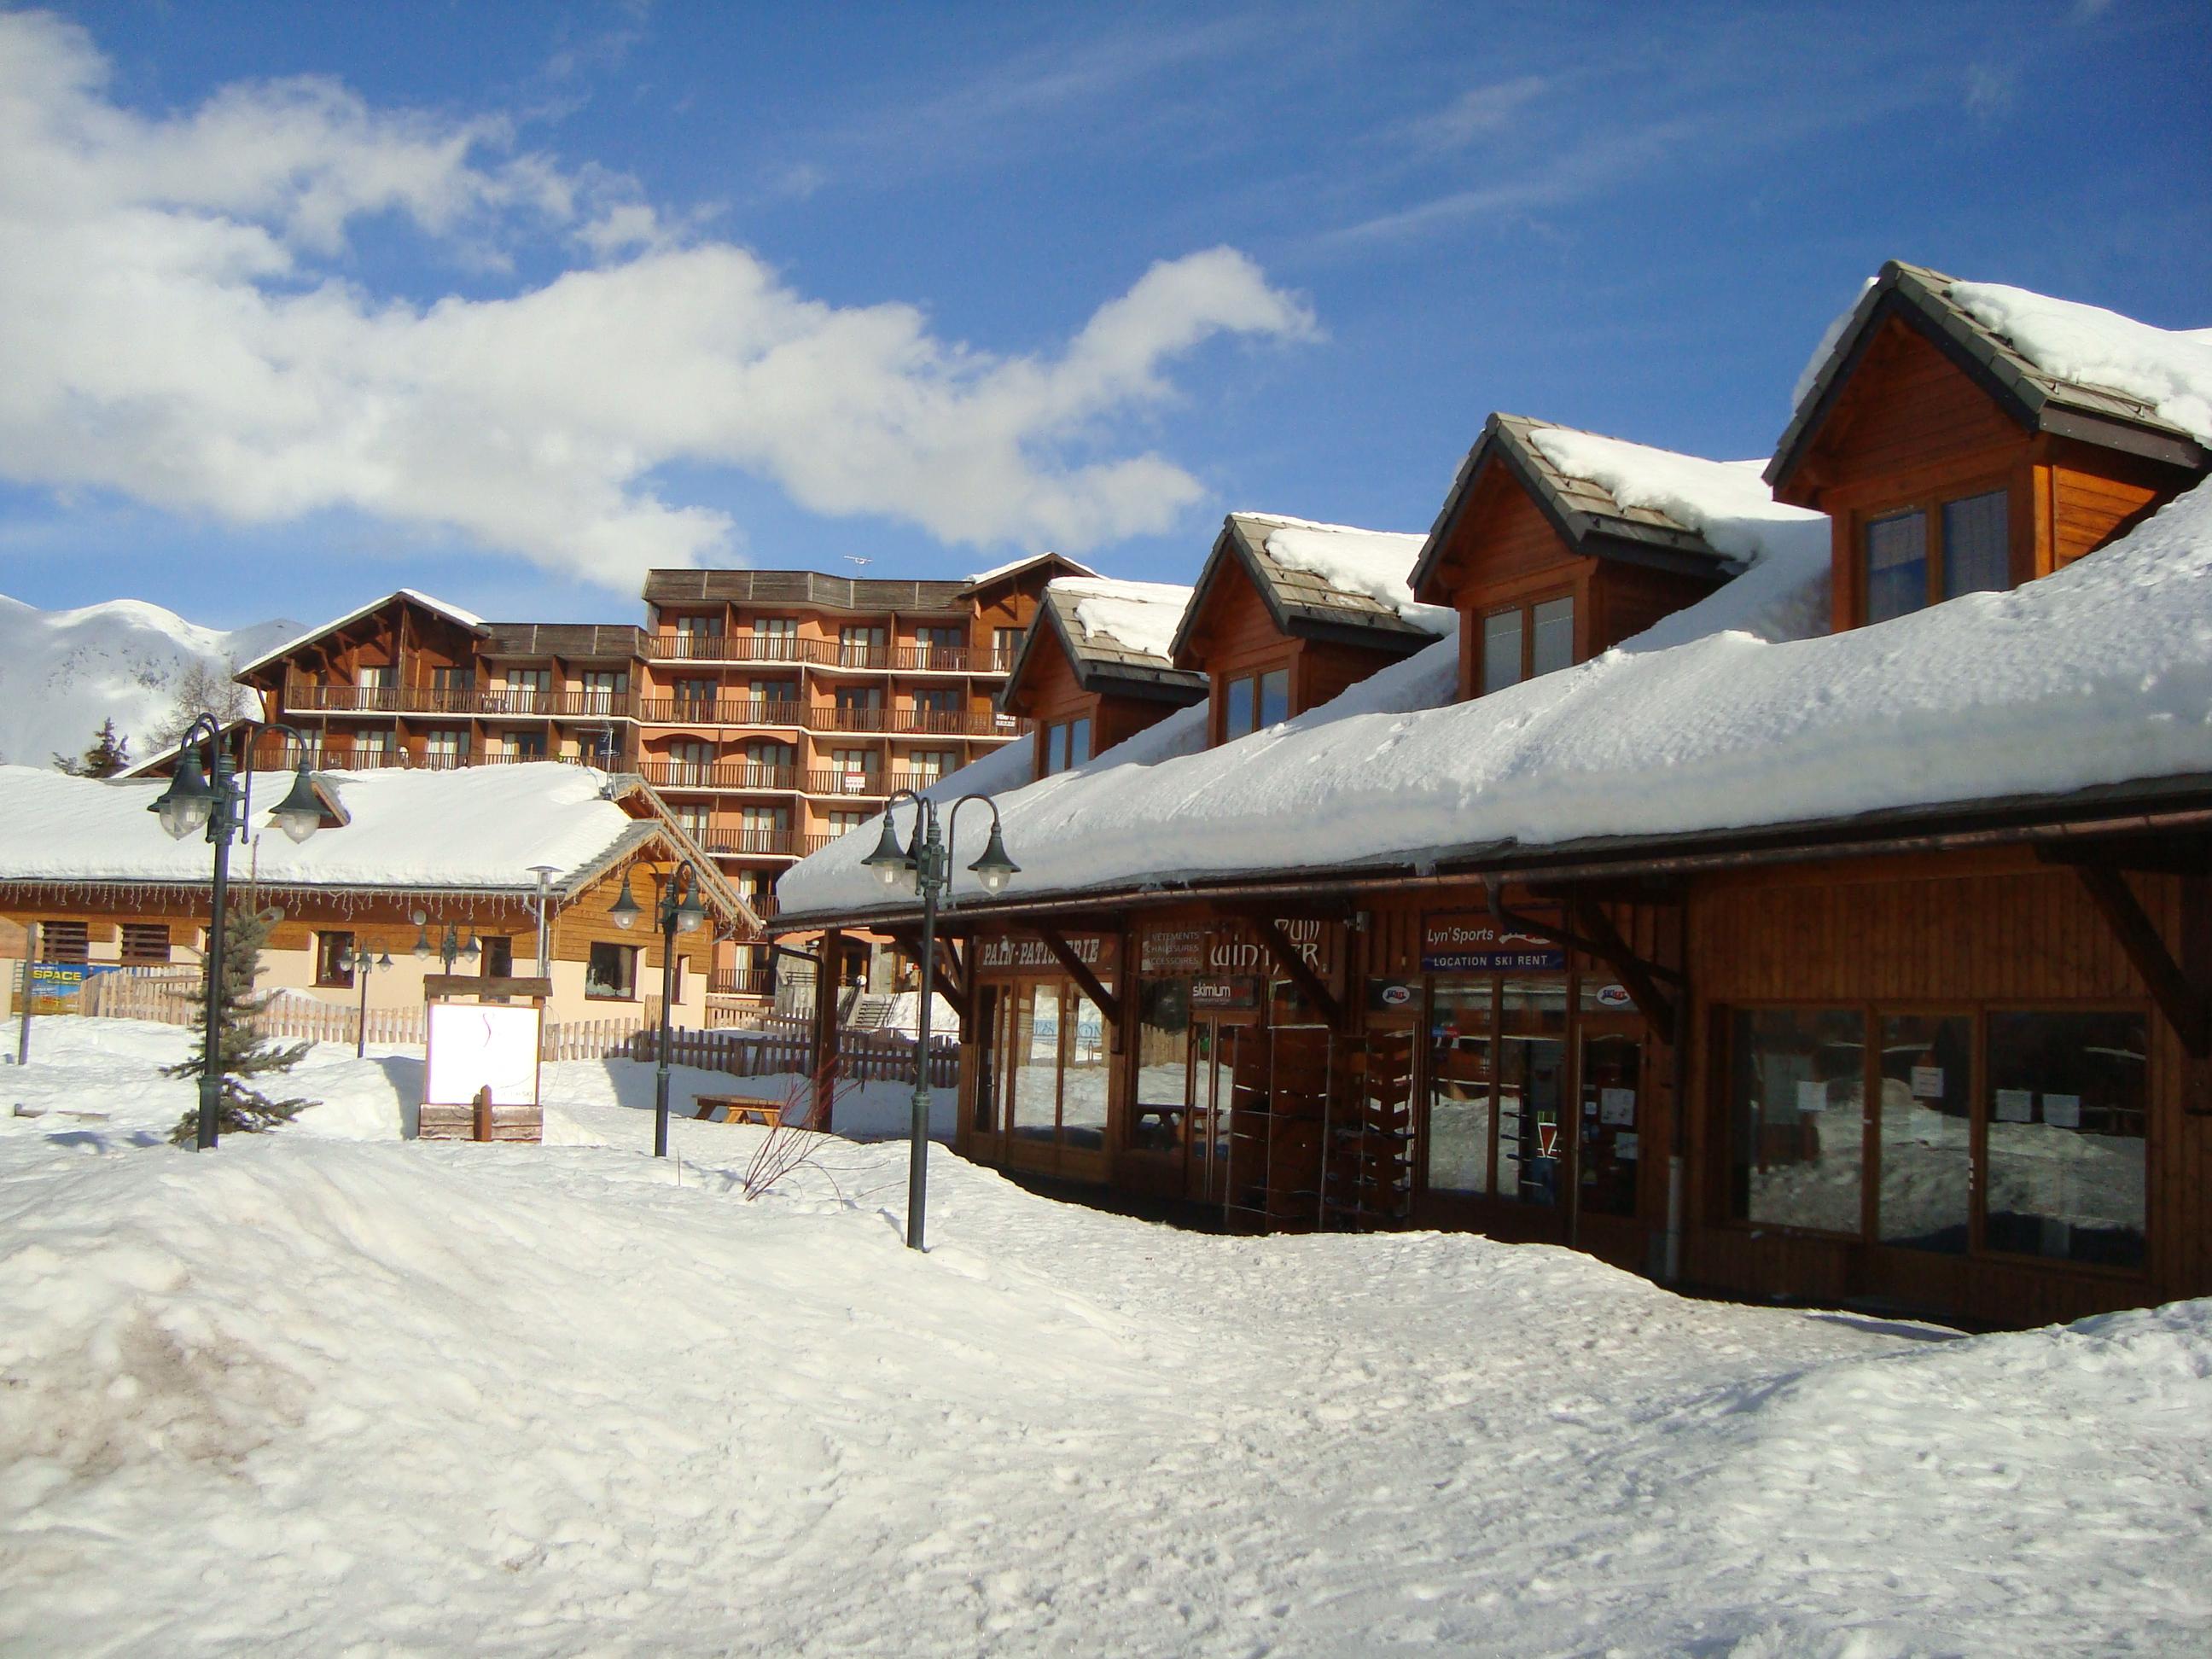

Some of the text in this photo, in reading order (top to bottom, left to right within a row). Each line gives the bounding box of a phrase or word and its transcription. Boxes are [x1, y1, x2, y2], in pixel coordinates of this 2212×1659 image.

[1428, 927, 1493, 946] Lyn'Sports
[983, 939, 1099, 965] PAIN PATISRIE
[1434, 955, 1548, 966] LOCATION SKI RENT
[1192, 981, 1231, 997] skimium
